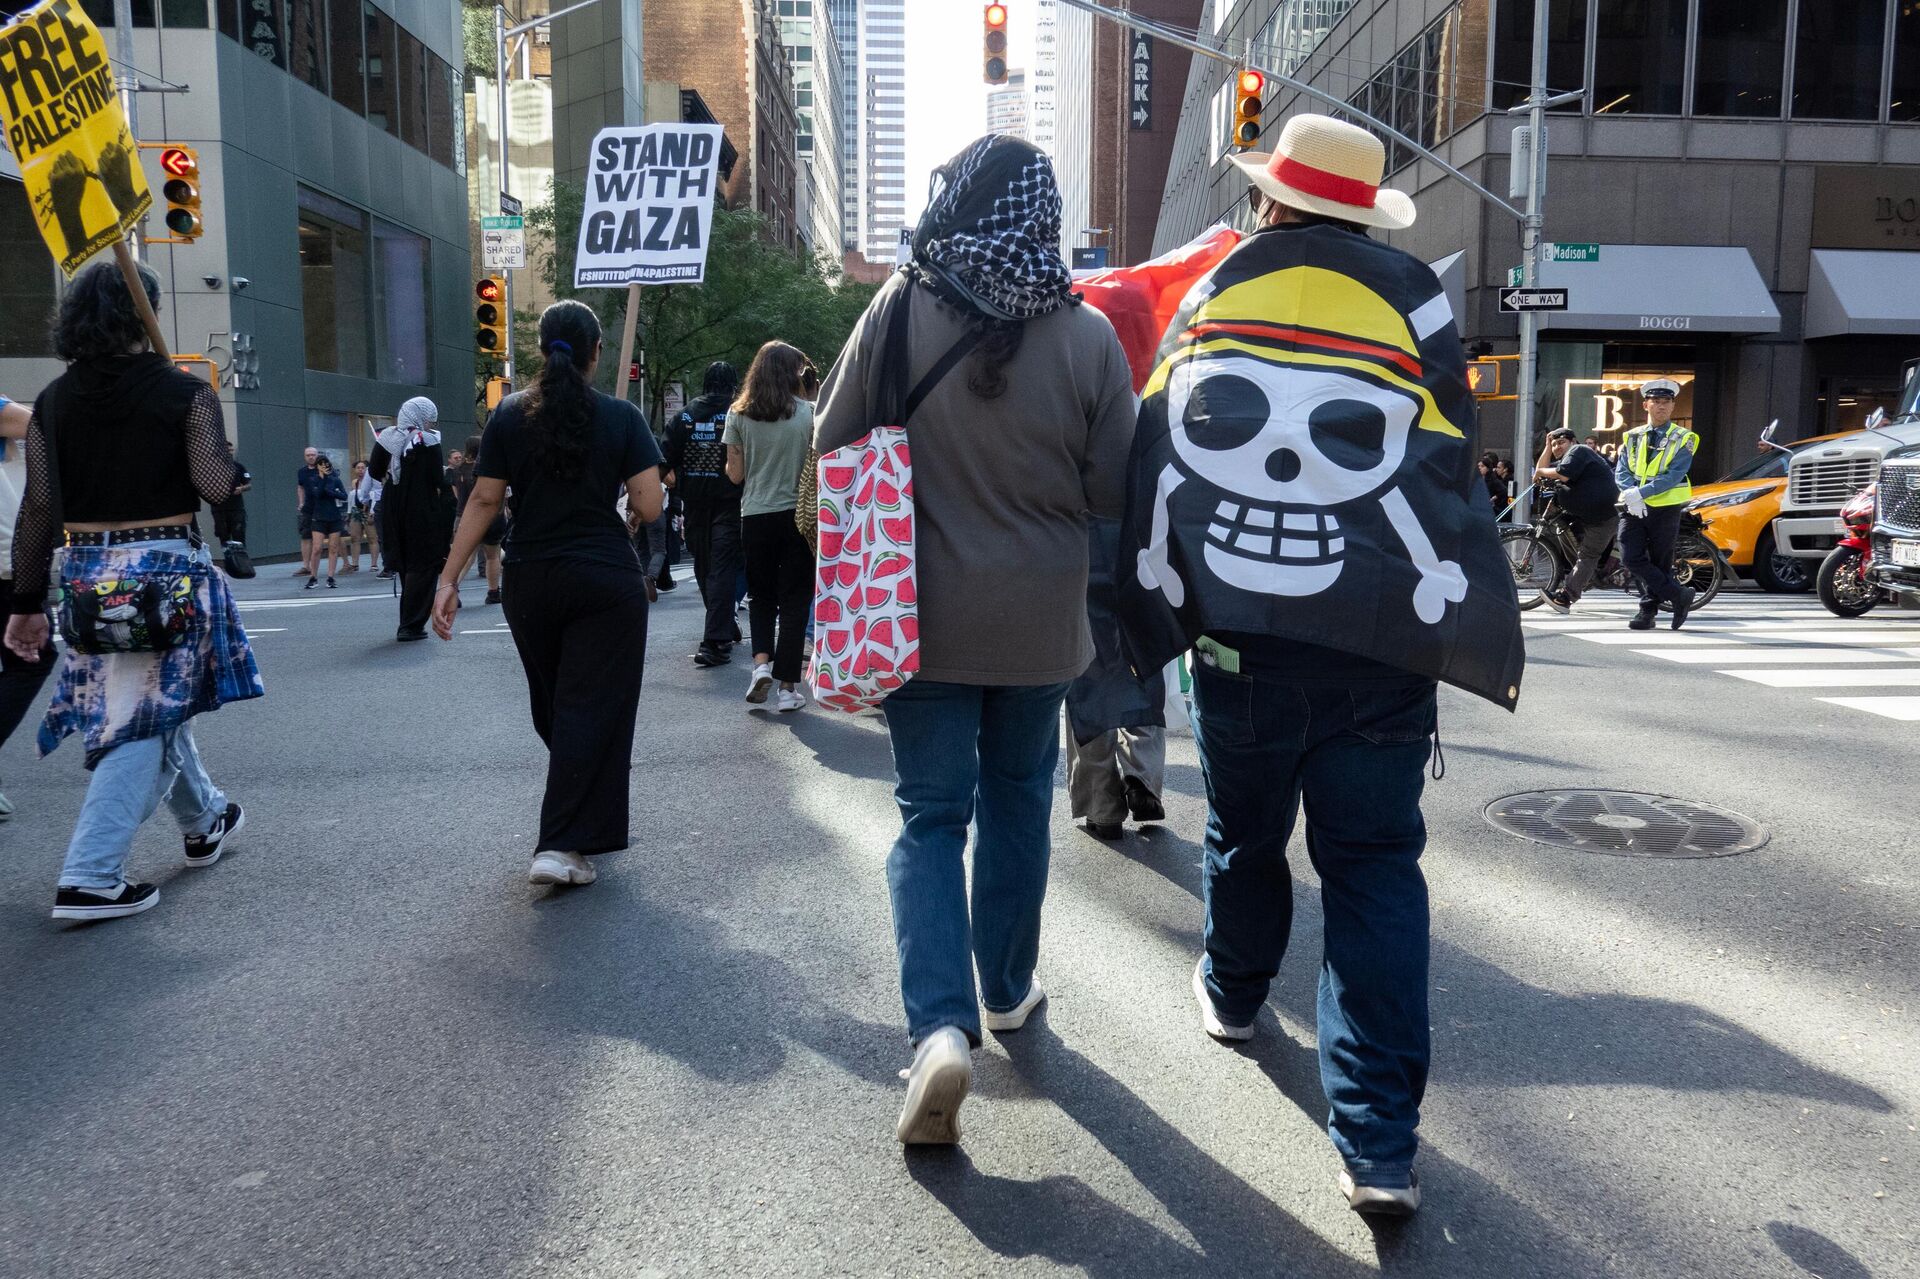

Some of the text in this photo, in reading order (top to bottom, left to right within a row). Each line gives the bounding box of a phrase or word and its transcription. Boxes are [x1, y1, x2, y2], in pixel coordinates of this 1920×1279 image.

[0, 0, 102, 122] FREE
[10, 63, 115, 164] PALESTINE
[596, 132, 714, 172] STAND
[594, 168, 709, 202] WITH
[585, 205, 701, 255] GAZA
[71, 250, 87, 266] Party
[86, 244, 97, 255] for
[486, 246, 521, 254] SHARED
[492, 256, 516, 265] LANE
[1553, 246, 1586, 260] Madison
[1588, 246, 1597, 254] Av
[580, 266, 698, 282] #SHUTITDOWN4PALESTINE
[1510, 295, 1560, 305] ONE WAY
[1640, 316, 1690, 329] BOGGI
[1591, 395, 1624, 431] B
